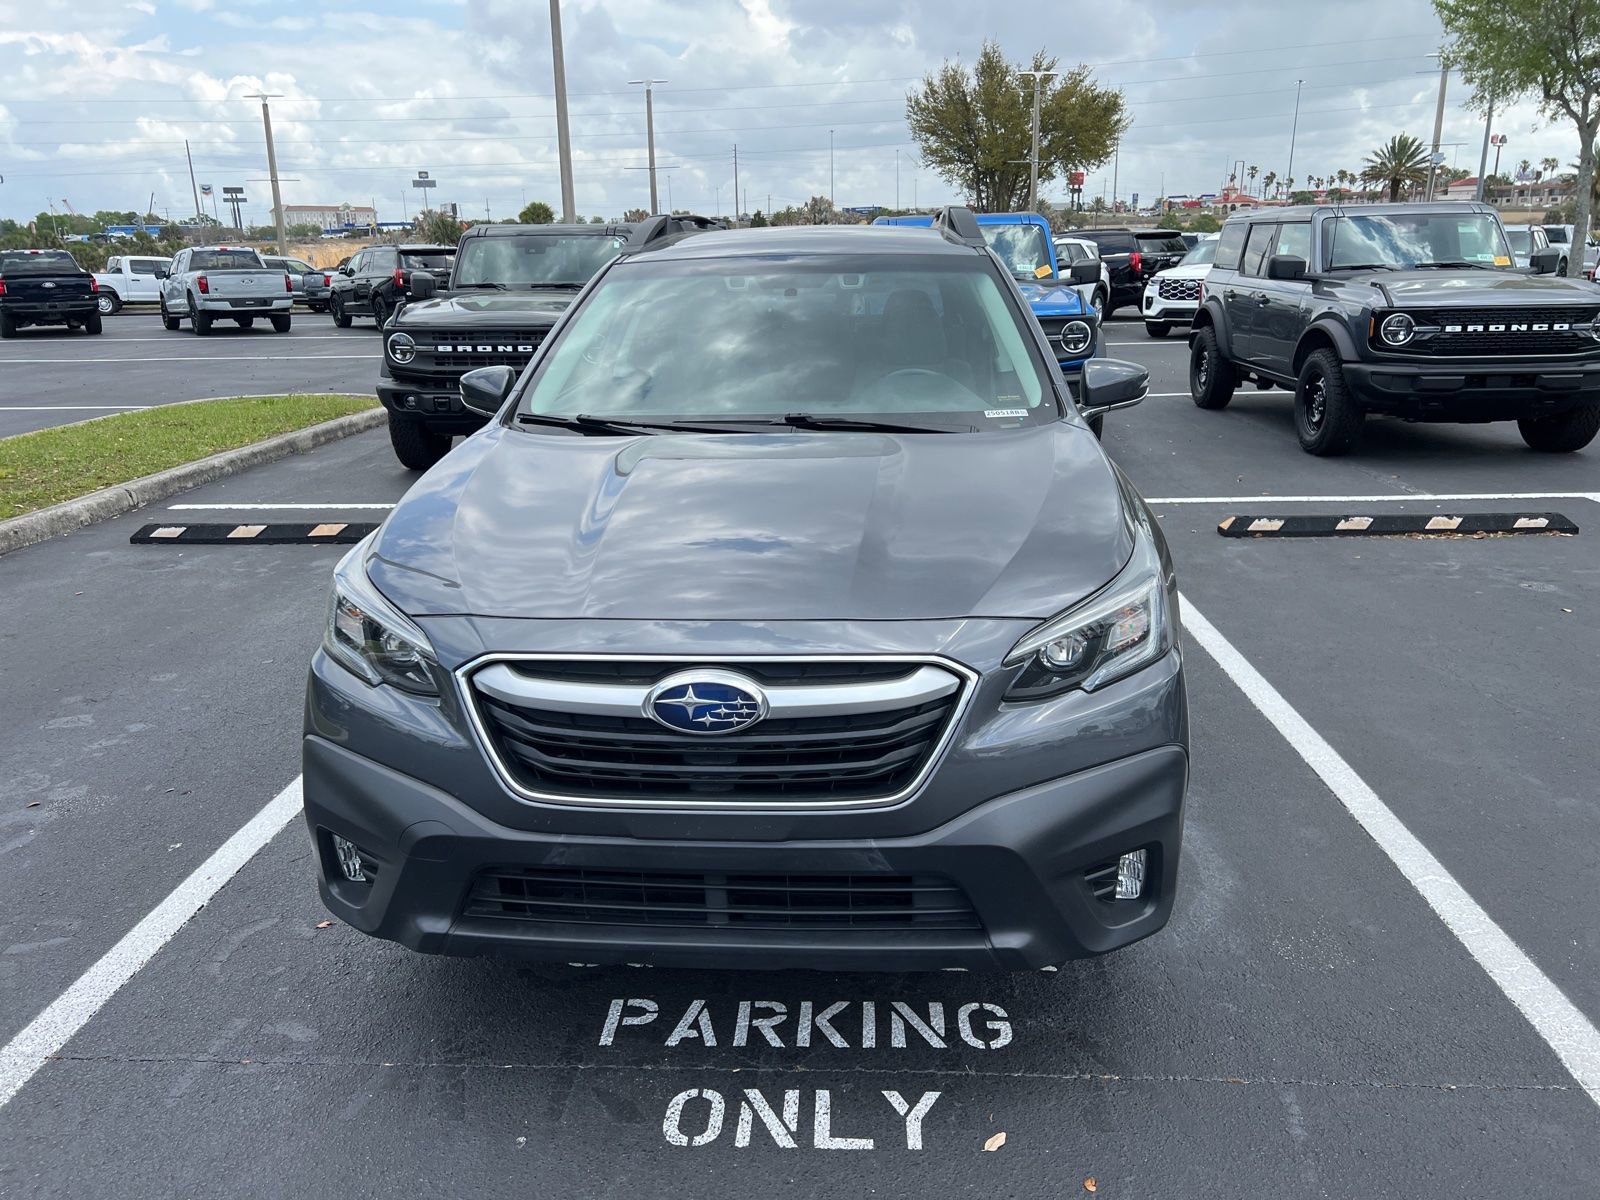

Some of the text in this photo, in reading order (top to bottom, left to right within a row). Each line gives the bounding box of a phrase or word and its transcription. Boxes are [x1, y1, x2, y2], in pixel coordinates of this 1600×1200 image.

[1444, 323, 1570, 332] BRONCO
[598, 998, 1013, 1049] PARKING
[662, 1088, 942, 1150] ONLY
